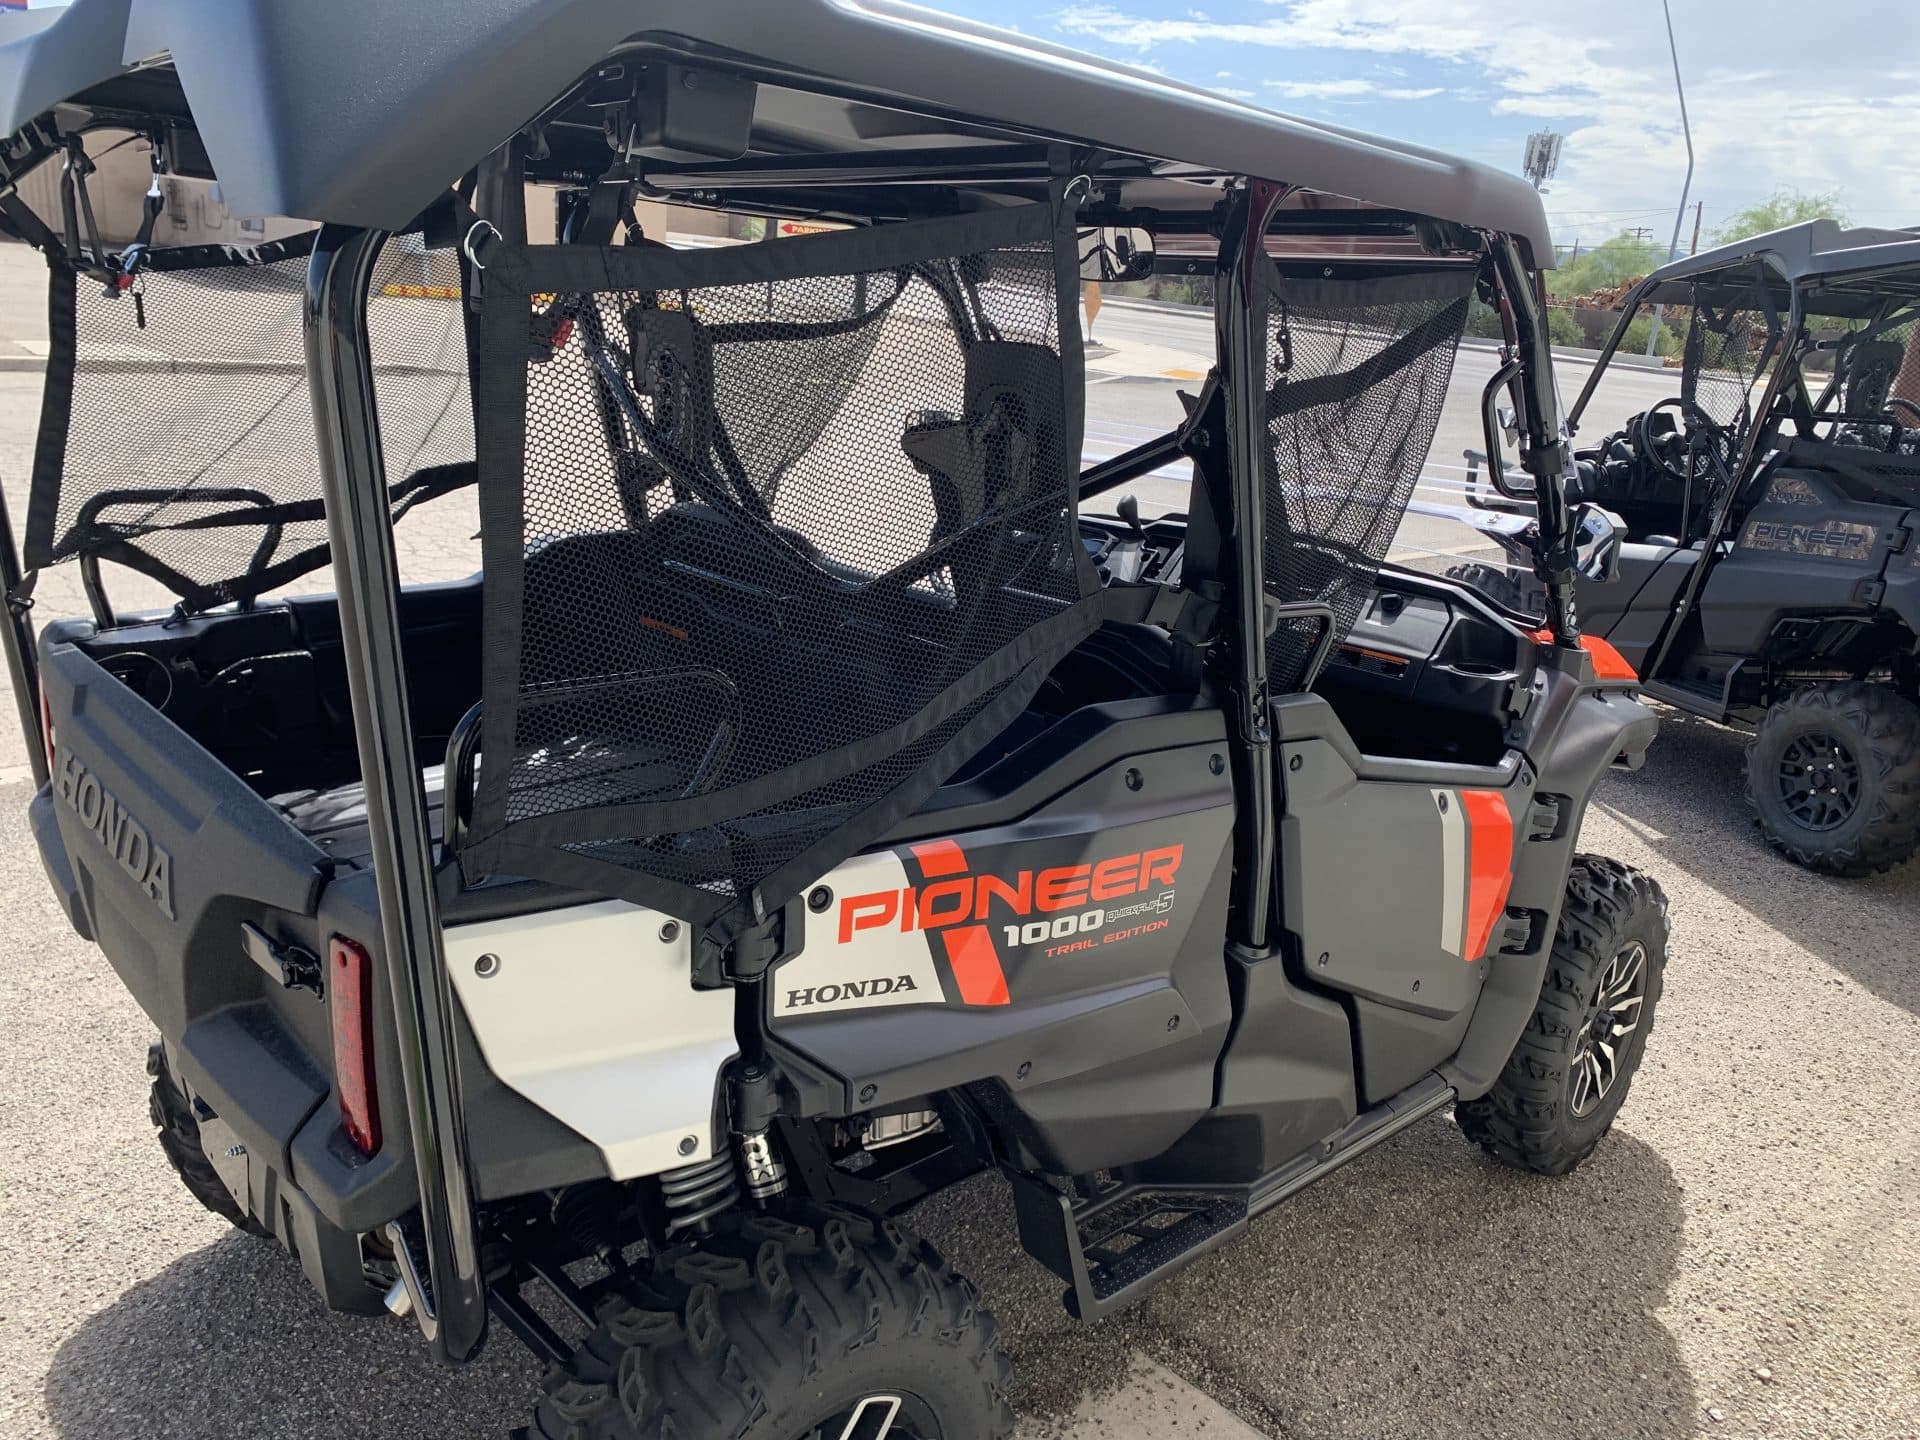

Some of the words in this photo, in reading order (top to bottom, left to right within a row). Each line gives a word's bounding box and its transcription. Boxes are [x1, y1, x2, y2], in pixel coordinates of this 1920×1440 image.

[1754, 524, 1866, 548] PIONEER
[56, 748, 176, 921] HONDA
[837, 843, 1184, 945] PIONEER
[1003, 909, 1105, 947] 1000
[1044, 939, 1099, 958] TRAIL
[1103, 919, 1169, 944] EDITION
[785, 974, 918, 1009] HONDA
